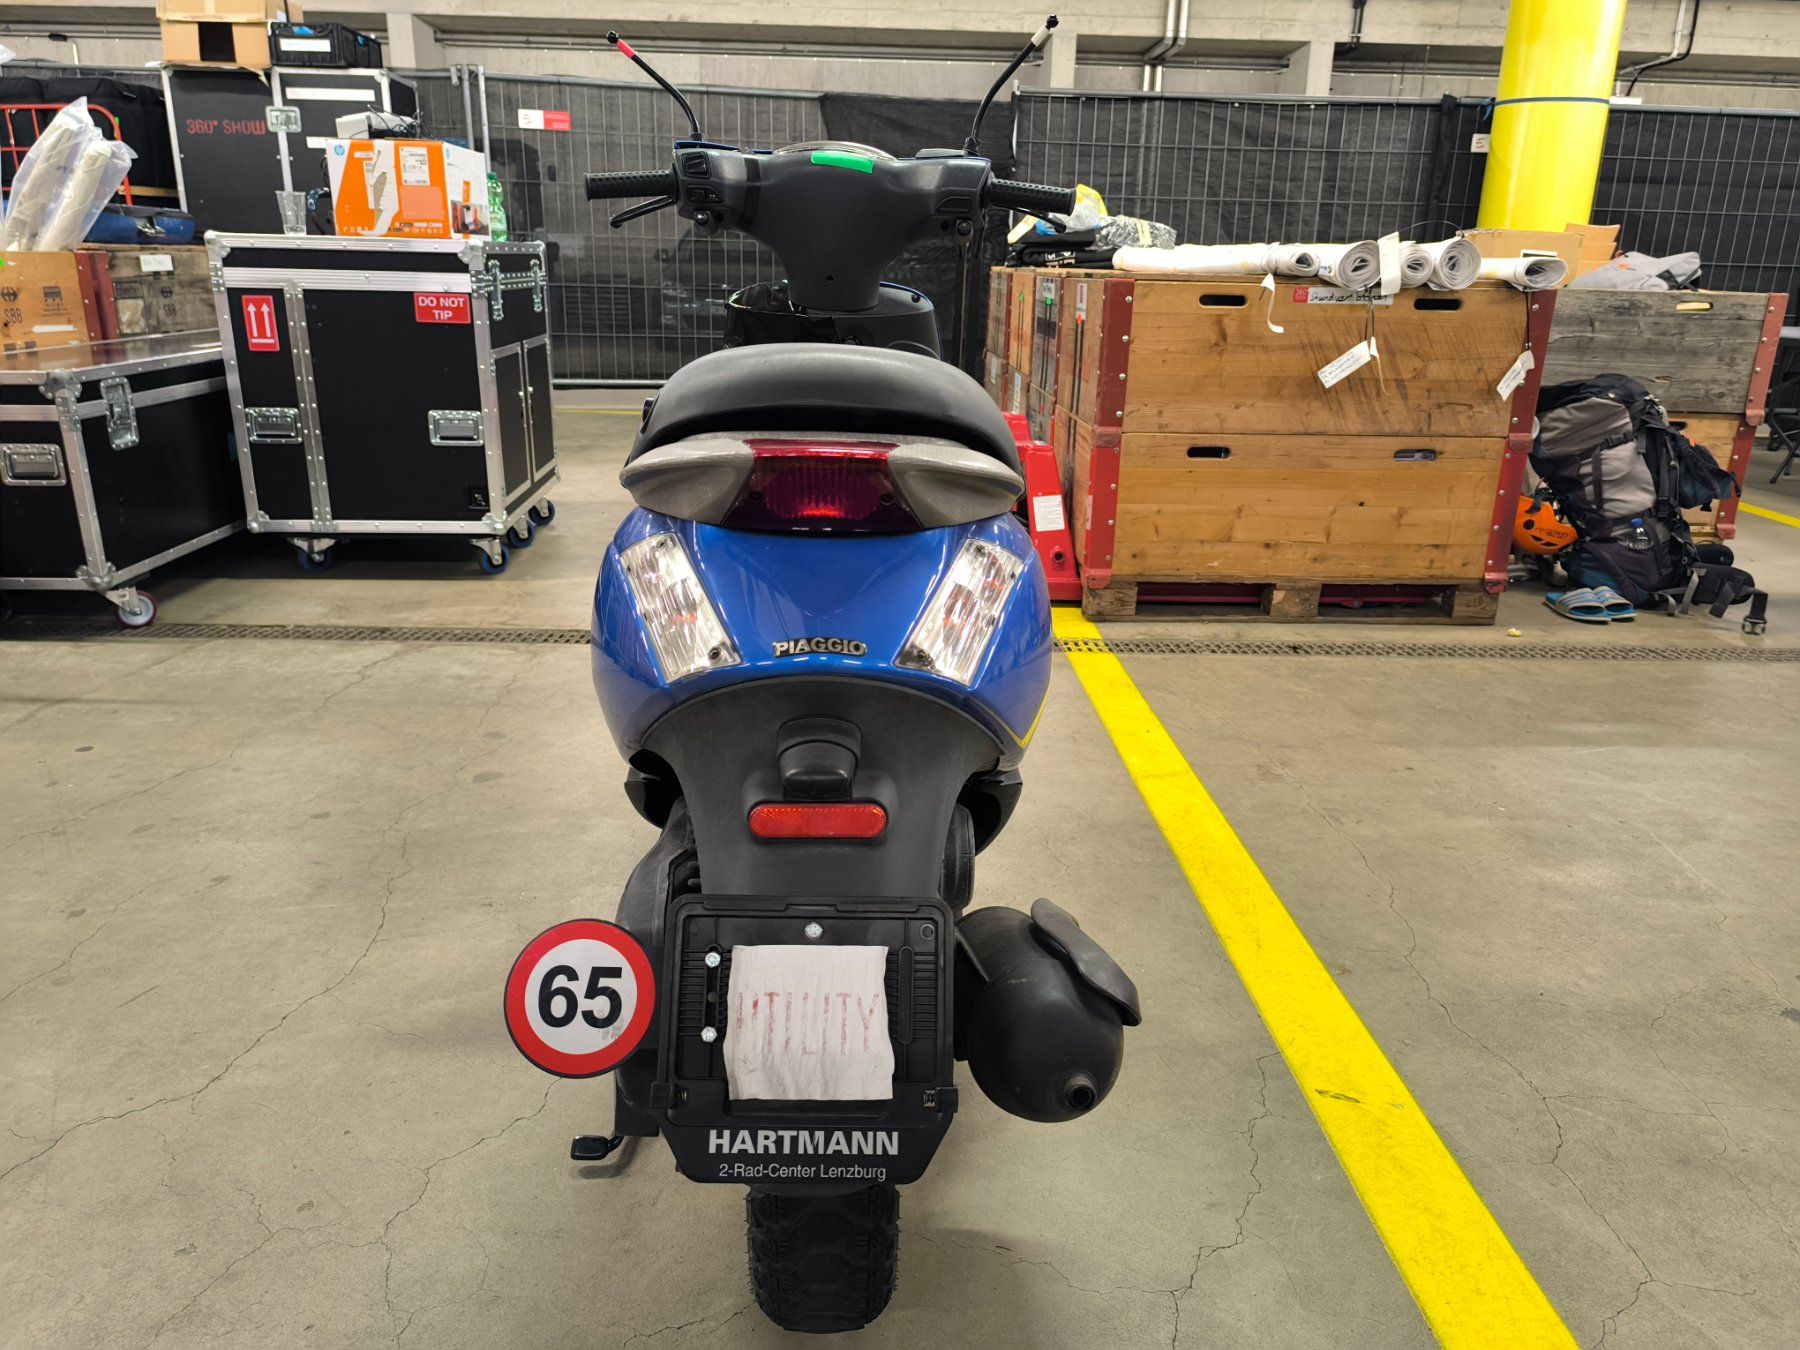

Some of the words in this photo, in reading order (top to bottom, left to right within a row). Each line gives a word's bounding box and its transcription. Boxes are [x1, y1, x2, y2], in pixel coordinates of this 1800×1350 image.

[222, 120, 268, 136] SHOW
[418, 296, 437, 307] DO
[440, 297, 465, 308] NOT
[4, 307, 23, 324] SBB
[432, 309, 453, 320] TIP
[773, 637, 866, 657] PIAGGIO
[538, 964, 623, 1029] 65
[708, 1129, 899, 1156] HARTMANN
[719, 1163, 817, 1178] 2-Rad-Center
[820, 1164, 887, 1182] Lenzburg
